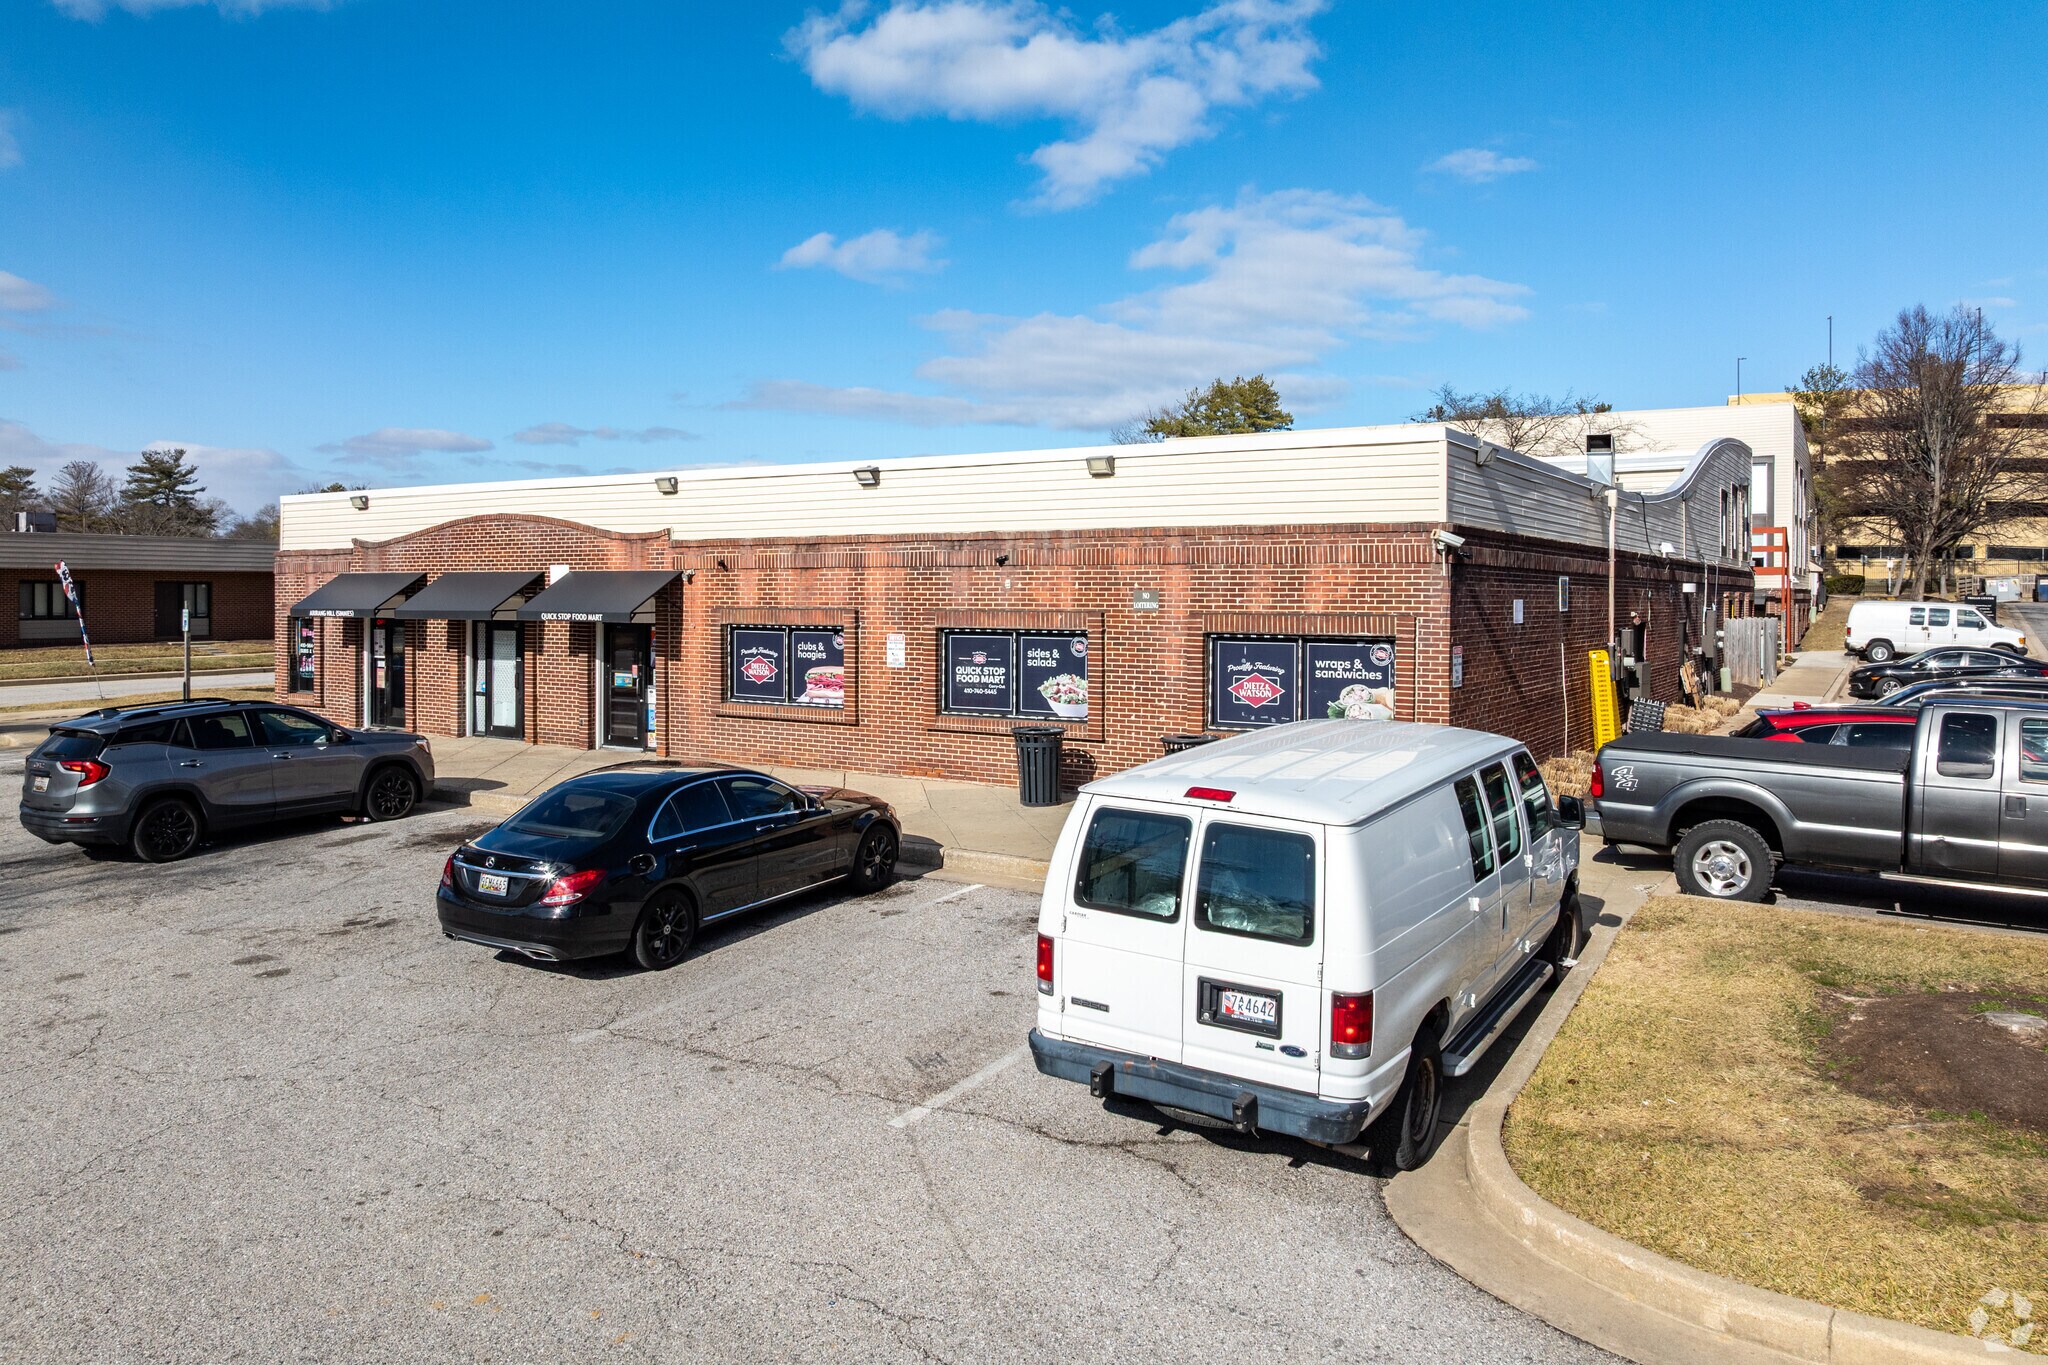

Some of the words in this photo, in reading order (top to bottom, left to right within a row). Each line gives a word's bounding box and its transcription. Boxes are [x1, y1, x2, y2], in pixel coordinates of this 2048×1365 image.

[541, 612, 557, 620] QUICK
[798, 642, 816, 651] clubs
[818, 642, 825, 651] &
[798, 650, 826, 660] hoagies
[1027, 648, 1050, 658] sides
[1052, 649, 1060, 658] &
[1027, 658, 1057, 667] salads
[1315, 660, 1351, 670] wraps
[1354, 659, 1363, 669] &
[955, 666, 982, 675] QUICK
[983, 667, 1006, 675] STOP
[1227, 662, 1253, 672] Proudly
[1253, 662, 1286, 675] Featuring
[1315, 669, 1382, 680] sandwiches
[981, 675, 1005, 684] MART
[1243, 682, 1264, 690] DIETZ
[1239, 689, 1272, 698] WATSON
